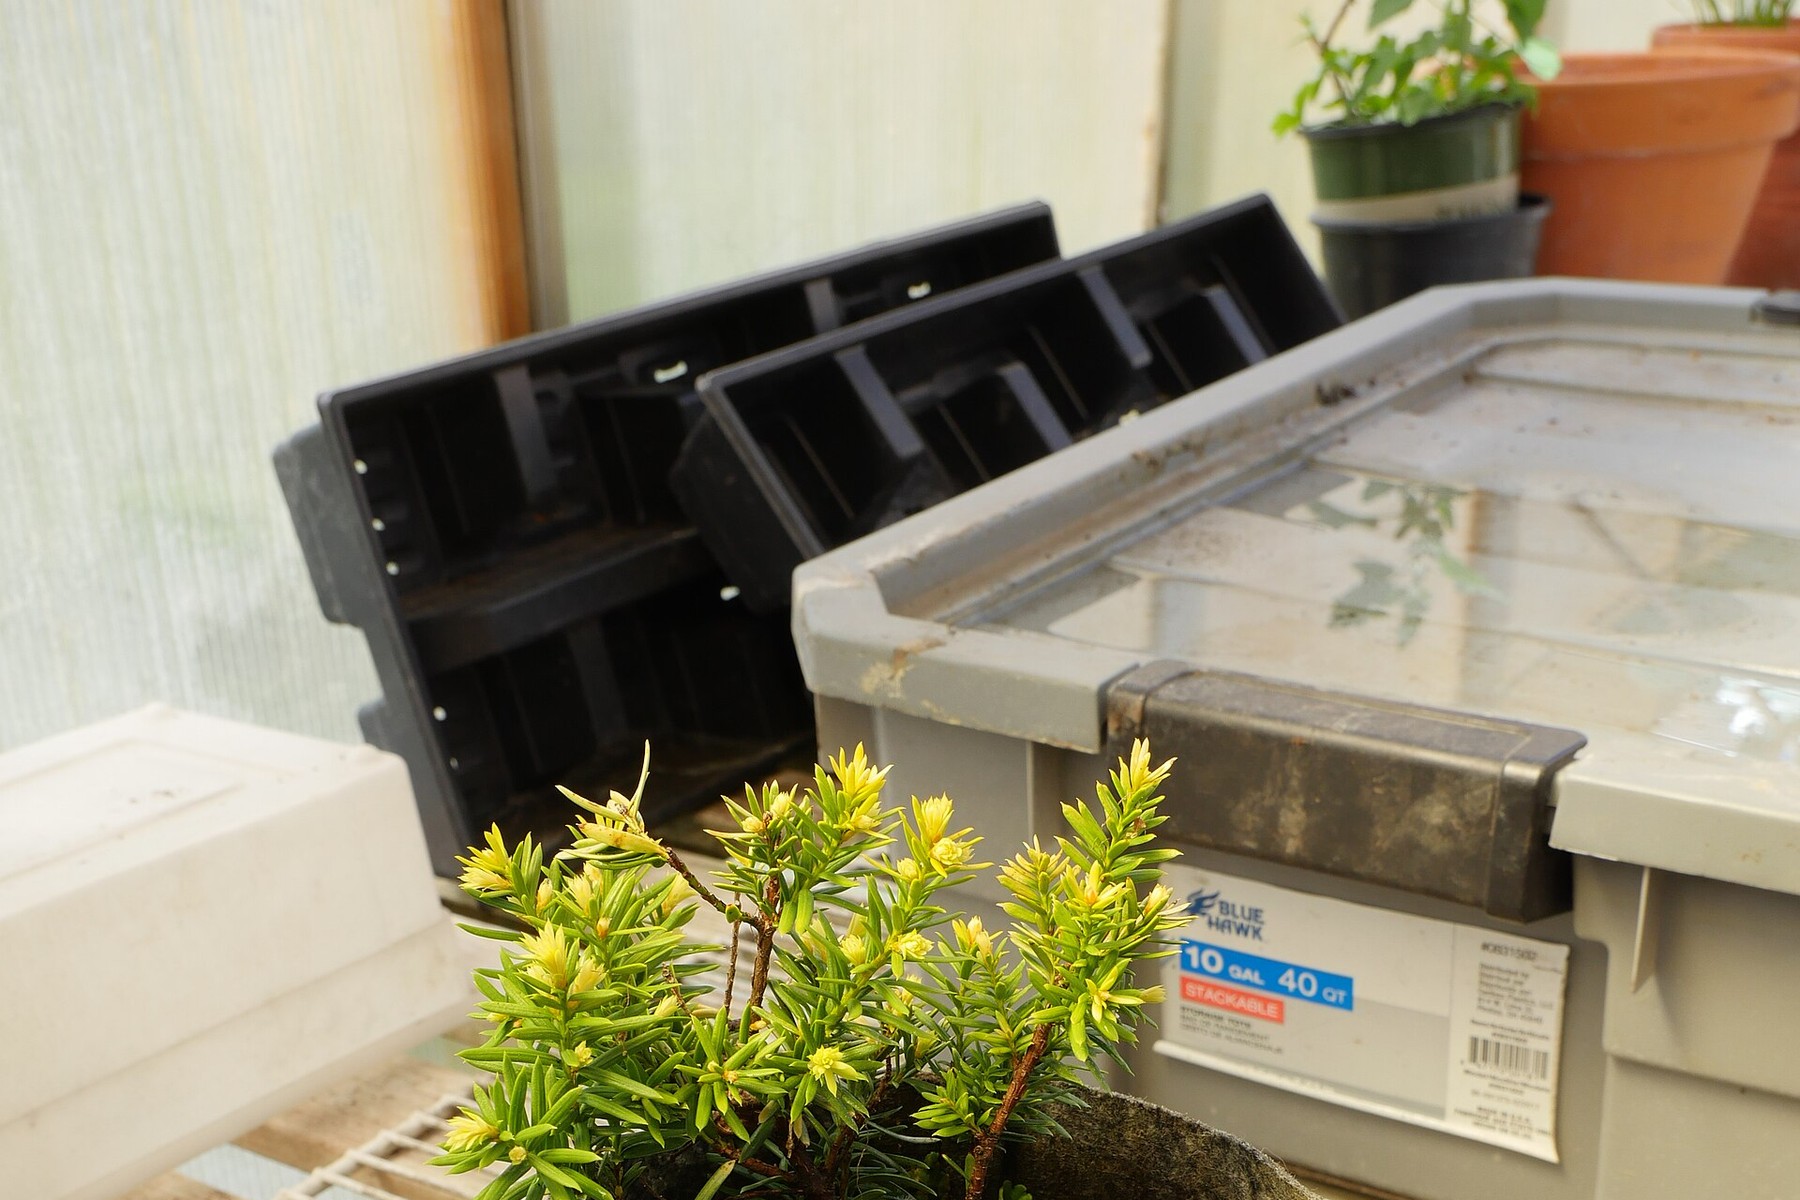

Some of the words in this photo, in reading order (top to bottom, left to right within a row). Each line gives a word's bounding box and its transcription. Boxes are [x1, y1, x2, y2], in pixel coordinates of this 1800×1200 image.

[1207, 915, 1264, 941] HAWK
[1218, 901, 1265, 924] BLUE
[1185, 945, 1224, 975] 10
[1228, 964, 1265, 986] GAL
[1277, 968, 1319, 998] 40
[1322, 987, 1348, 1004] QT
[1184, 982, 1279, 1018] STACKABLE
